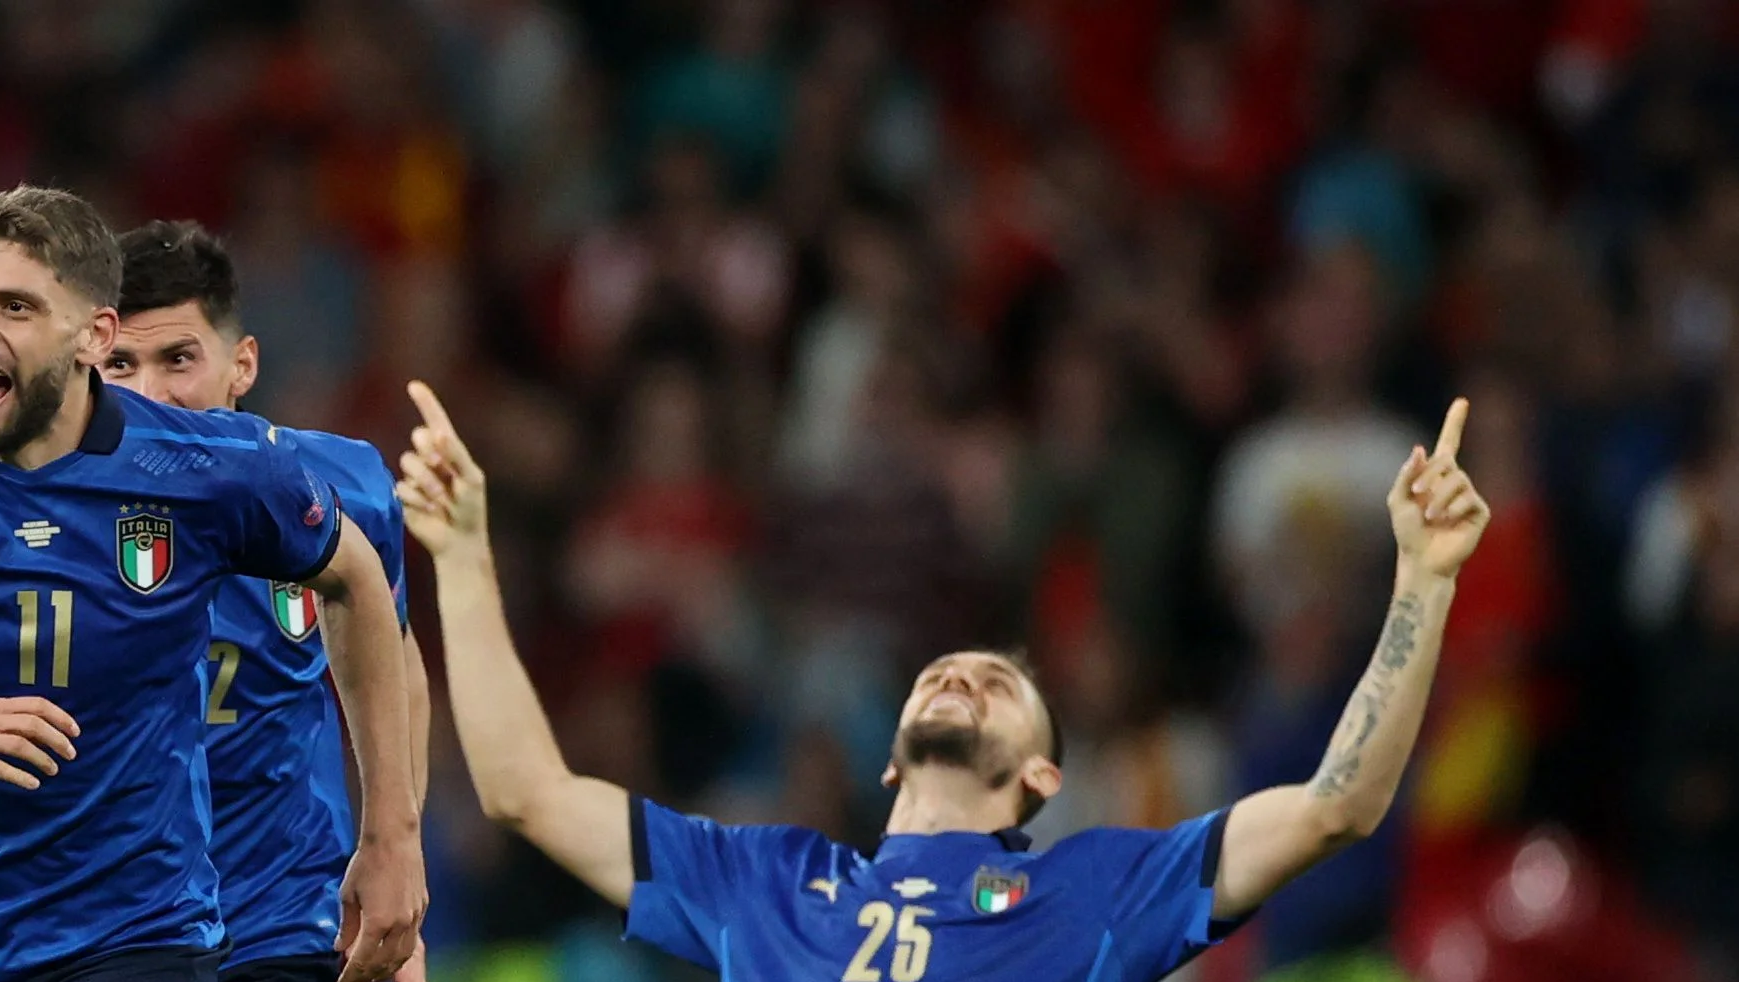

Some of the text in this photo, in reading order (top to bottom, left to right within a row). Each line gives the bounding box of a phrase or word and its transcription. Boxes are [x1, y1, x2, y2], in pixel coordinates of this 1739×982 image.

[121, 521, 168, 534] ITALIA
[16, 590, 73, 688] 11
[206, 641, 241, 724] 2
